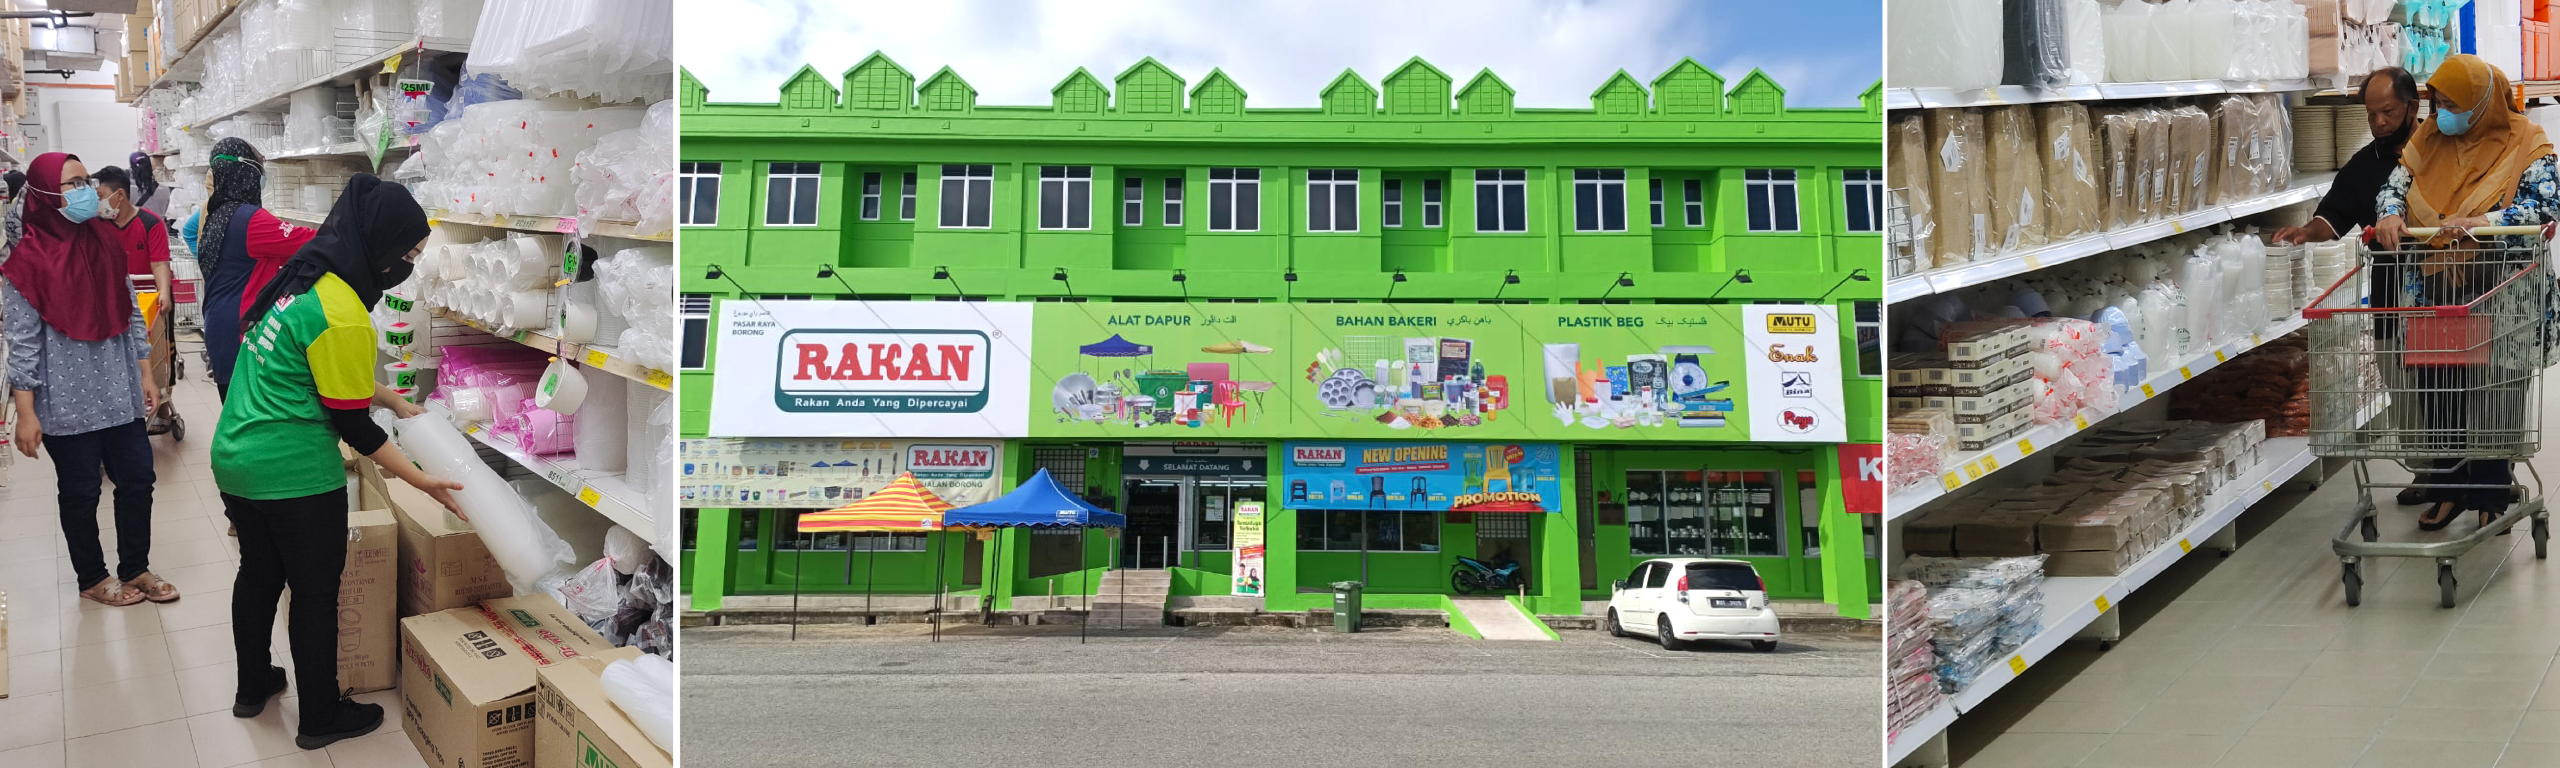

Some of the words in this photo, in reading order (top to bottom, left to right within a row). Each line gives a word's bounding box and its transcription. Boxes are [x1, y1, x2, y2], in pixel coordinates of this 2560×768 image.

[1108, 315, 1141, 325] ALAT
[1145, 315, 1191, 326] DAPUR
[1336, 316, 1384, 326] BAHAN
[1388, 316, 1436, 326] BAKERI
[1558, 317, 1612, 327] PLASTIK
[1617, 317, 1644, 327] BEG
[1773, 316, 1810, 326] MUTU
[1768, 343, 1819, 363] Enak
[793, 342, 974, 381] RAKAN
[795, 398, 829, 408] Rakan
[837, 398, 865, 408] Anda
[873, 398, 900, 410] Yang
[908, 398, 968, 410] Dipercayai
[913, 450, 988, 467] RAKAN
[1296, 448, 1342, 460] RAKAN
[1363, 448, 1392, 463] NEW
[1393, 445, 1447, 462] OPENING
[1454, 491, 1542, 508] PROMOTION
[414, 718, 434, 753] Packaging
[434, 745, 444, 766] Tape
